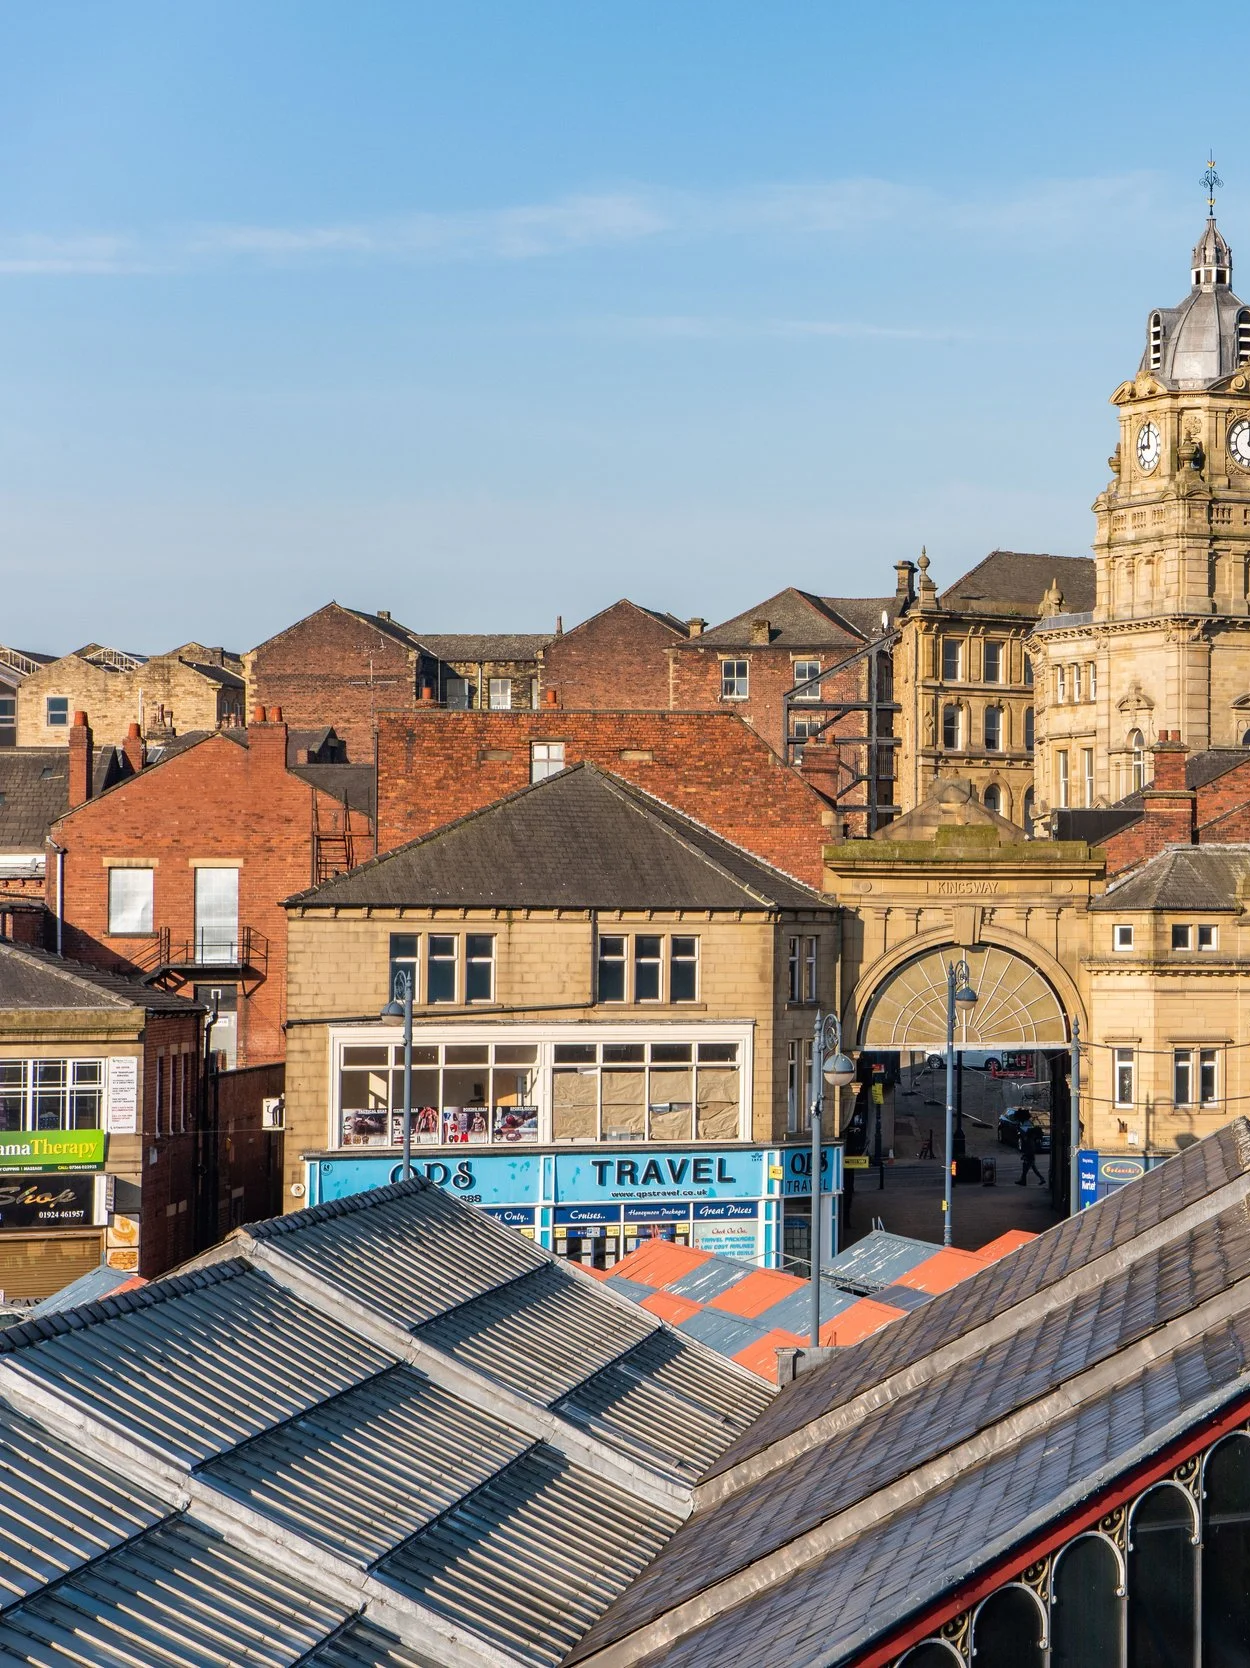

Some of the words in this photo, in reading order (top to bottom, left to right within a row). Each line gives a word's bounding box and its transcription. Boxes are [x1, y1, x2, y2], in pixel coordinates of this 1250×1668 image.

[938, 881, 999, 894] KINGSWAY
[590, 1156, 737, 1186] TRAVEL
[611, 1188, 708, 1199] www.qpstravel.co.uk
[39, 1211, 59, 1219] 01924
[60, 1210, 84, 1218] 461957
[699, 1205, 725, 1217] Great
[726, 1204, 752, 1217] Prices
